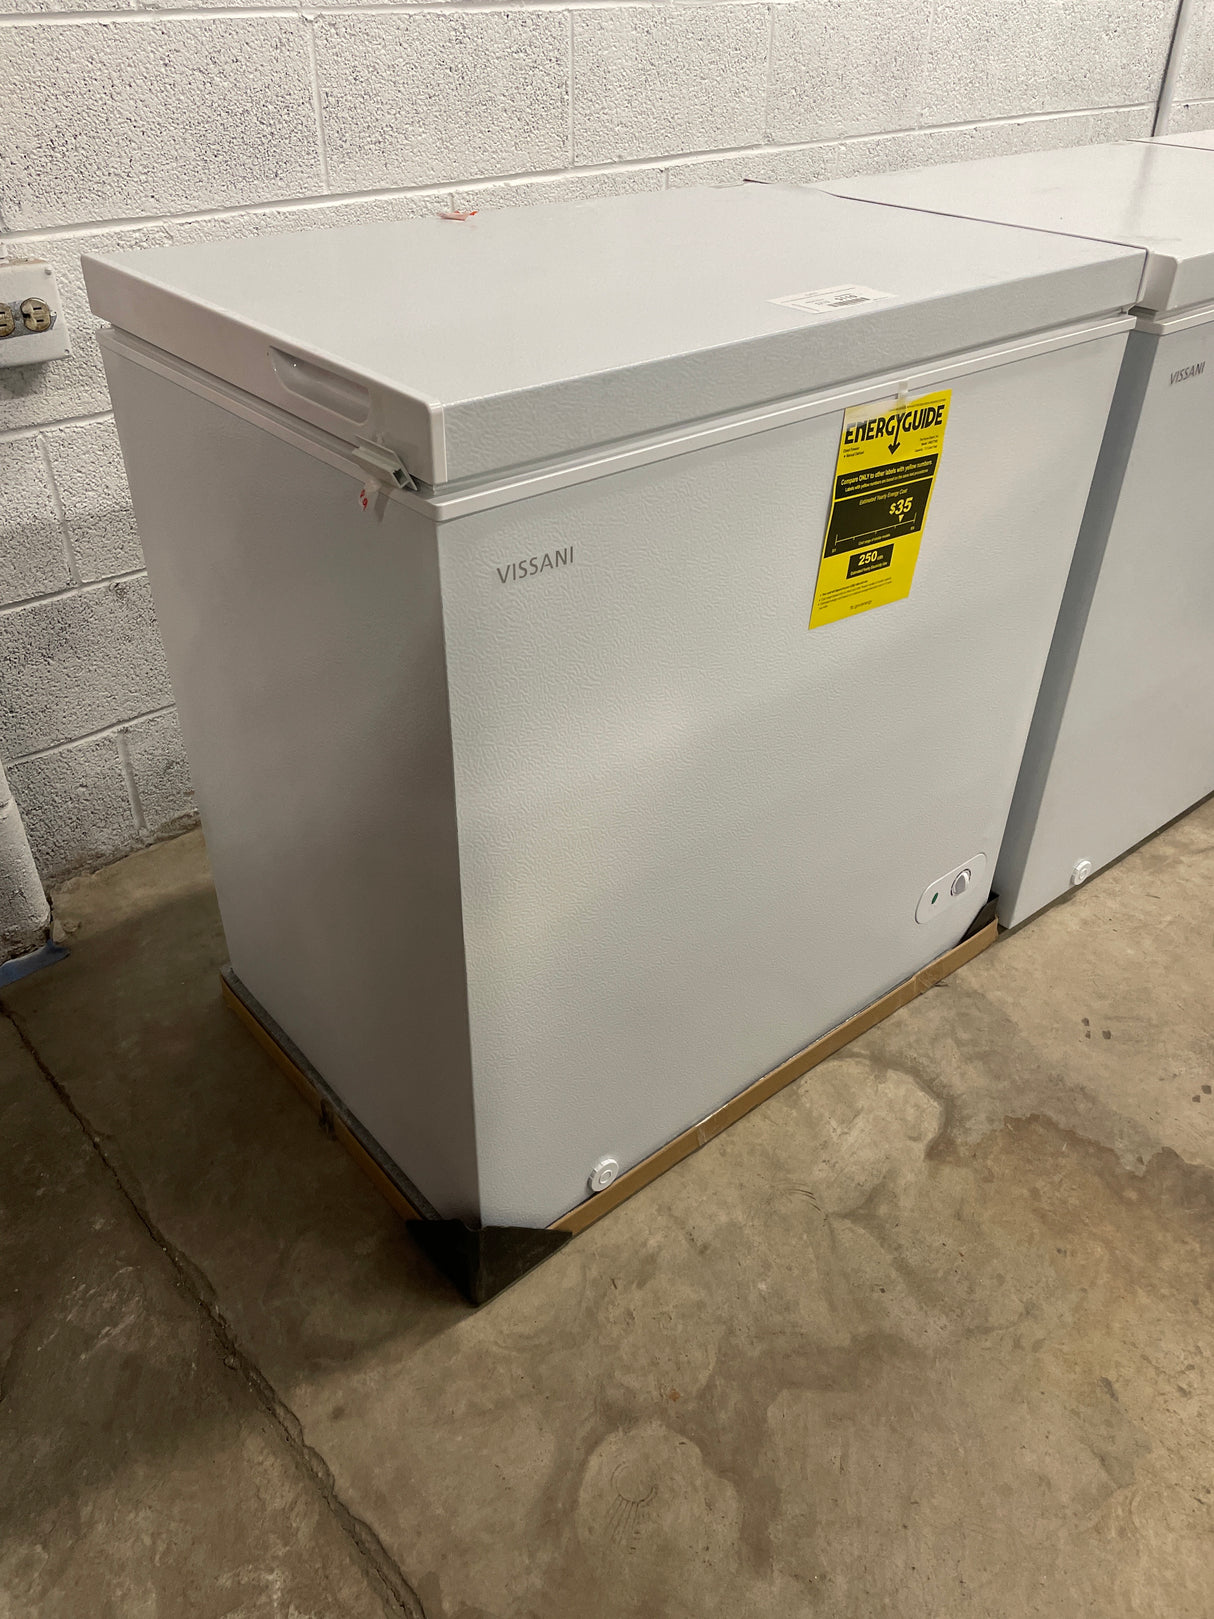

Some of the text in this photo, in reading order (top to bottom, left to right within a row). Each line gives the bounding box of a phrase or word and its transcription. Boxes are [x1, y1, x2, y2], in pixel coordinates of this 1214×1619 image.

[1170, 361, 1206, 385] VISSANI
[844, 404, 945, 445] ENERGYGUIDE
[841, 475, 858, 486] Compare
[859, 473, 869, 481] ONLY
[875, 470, 885, 478] other
[885, 467, 897, 475] labels
[905, 463, 917, 471] yellow
[859, 496, 876, 505] Estimated
[877, 493, 887, 501] Yearly
[887, 490, 899, 499] Energy
[889, 497, 913, 515] $35
[496, 546, 573, 584] VISSANI
[858, 550, 878, 566] 250
